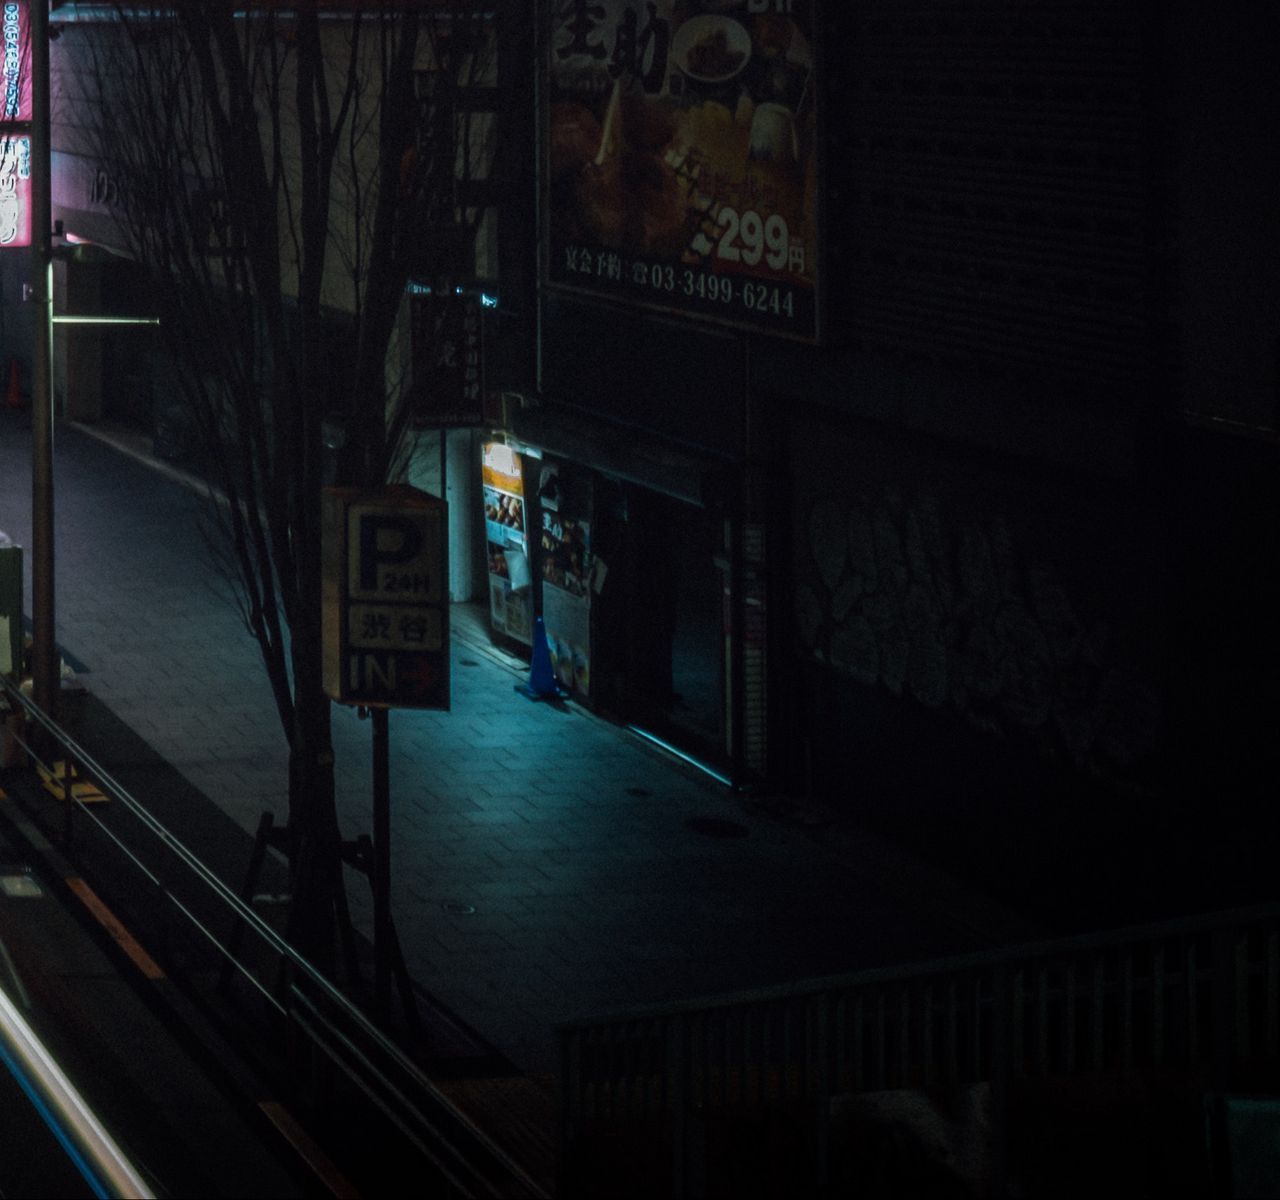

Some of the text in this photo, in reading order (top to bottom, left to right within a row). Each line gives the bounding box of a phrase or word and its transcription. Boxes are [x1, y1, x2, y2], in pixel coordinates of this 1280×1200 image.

[361, 514, 423, 591] P
[384, 572, 431, 593] 24H
[361, 613, 428, 643] 渋谷
[348, 653, 397, 691] IN
